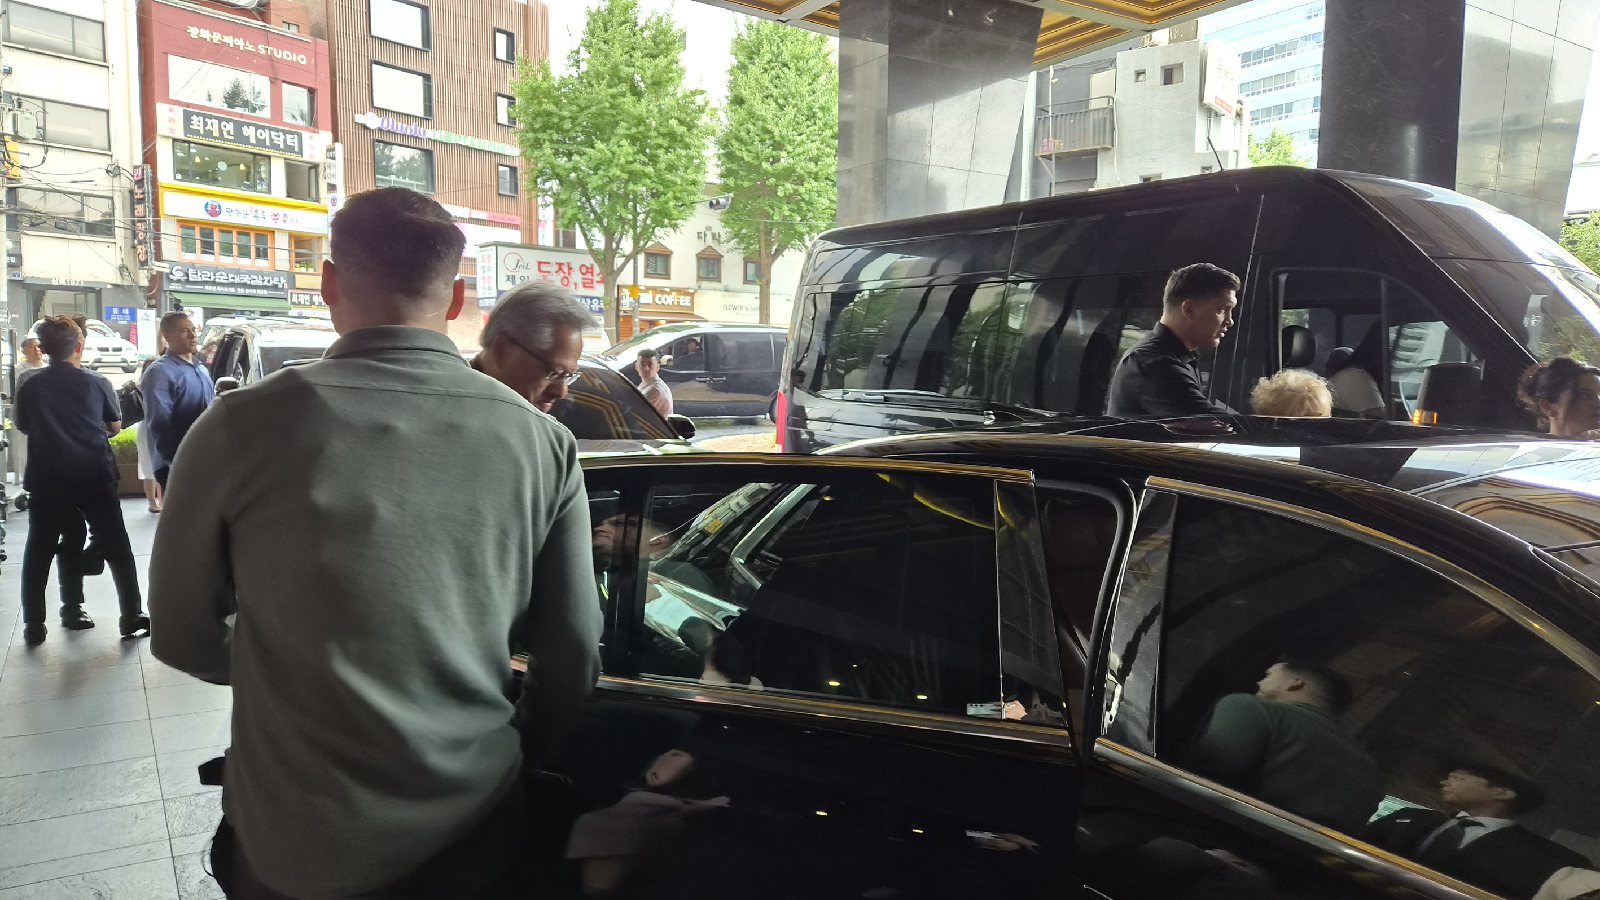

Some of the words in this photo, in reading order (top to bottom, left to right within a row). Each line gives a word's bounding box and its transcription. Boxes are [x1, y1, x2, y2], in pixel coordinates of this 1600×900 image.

[187, 25, 256, 52] 광화문피아노
[257, 44, 307, 65] STUDIO
[190, 114, 235, 140] 최재연
[242, 124, 299, 152] 헤어닥터
[187, 266, 287, 289] 탐라순대국감자탕
[655, 294, 692, 307] COFFEE
[723, 303, 744, 312] FLOWER
